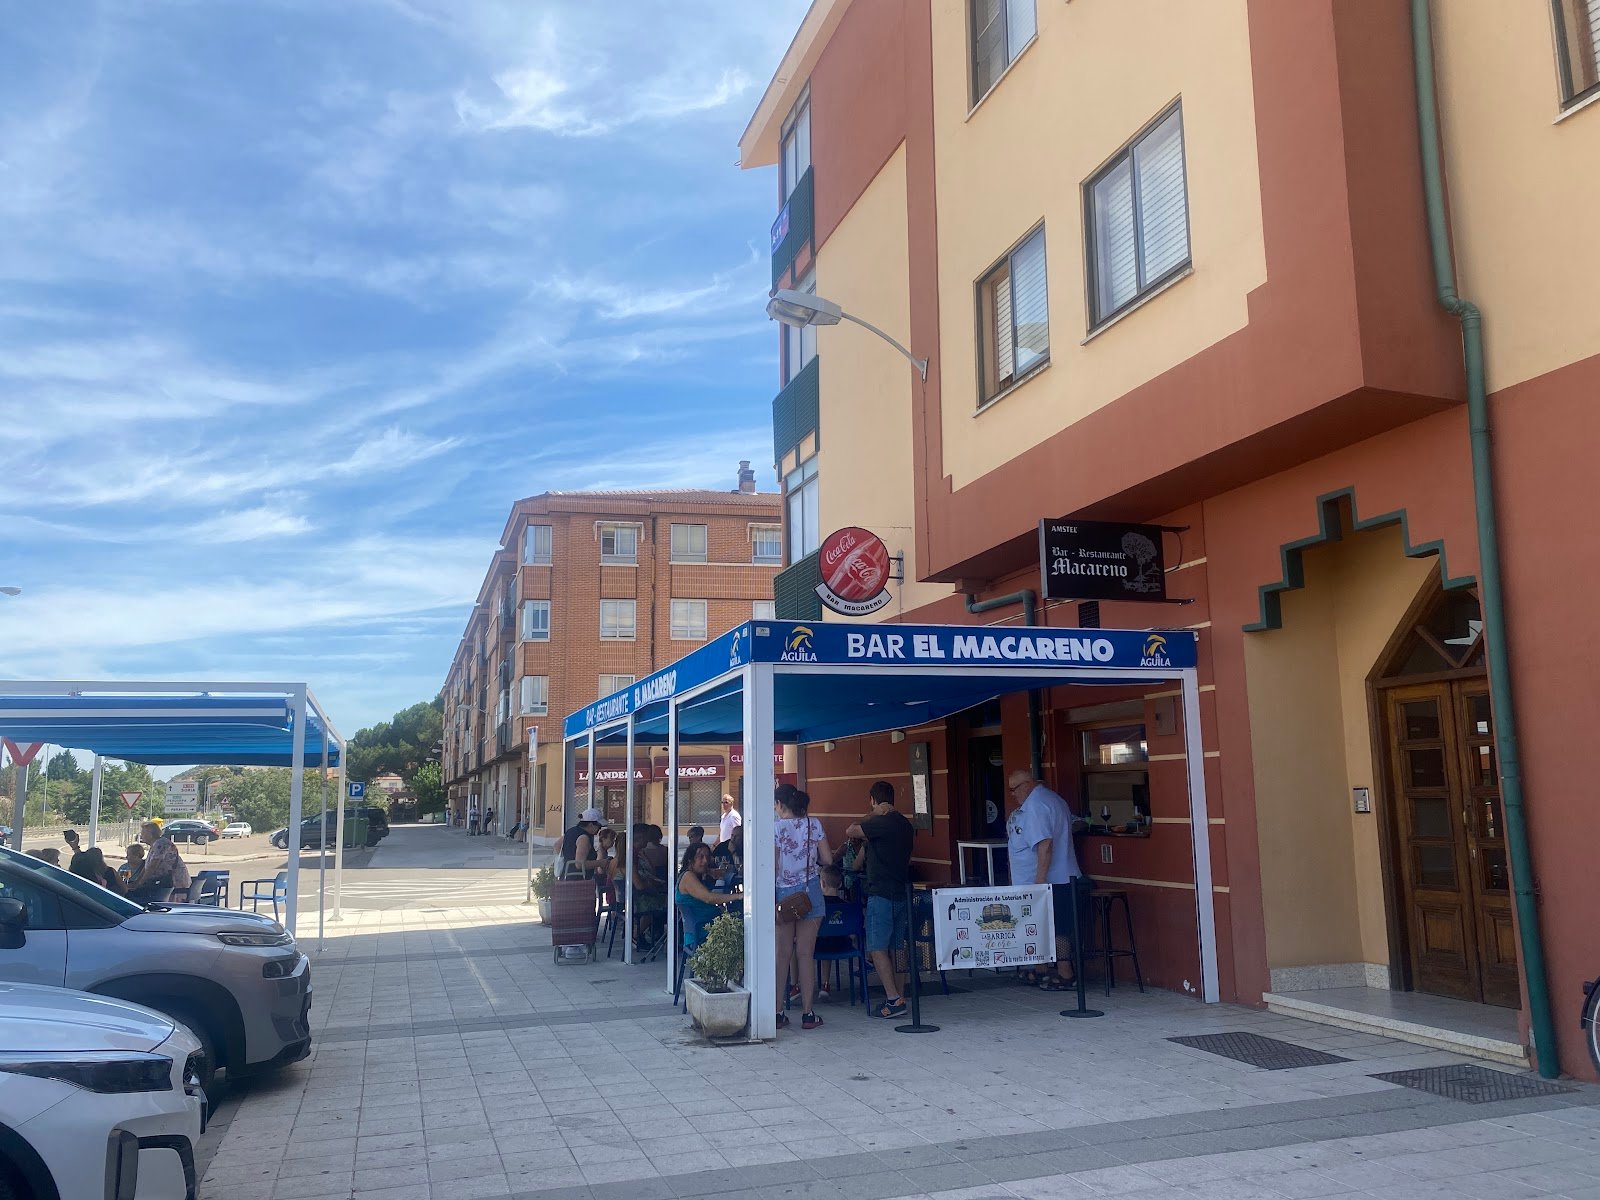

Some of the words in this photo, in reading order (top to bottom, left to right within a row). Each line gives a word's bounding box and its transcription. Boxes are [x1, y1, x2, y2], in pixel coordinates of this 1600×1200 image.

[1051, 525, 1078, 534] AMSTEL
[1051, 546, 1069, 557] Bar
[1078, 548, 1127, 560] Restaurante
[1051, 557, 1128, 577] Macareno
[826, 593, 840, 606] BAR
[844, 599, 883, 611] MACARENO
[847, 633, 905, 658] BAR
[913, 634, 945, 658] EL
[953, 635, 1115, 662] MACARENO
[586, 707, 594, 726] BAR
[597, 692, 629, 722] RESTAURANTE
[634, 687, 642, 709] EL
[642, 669, 677, 704] MACARENO
[351, 783, 362, 796] P
[987, 932, 1016, 940] BARRICA
